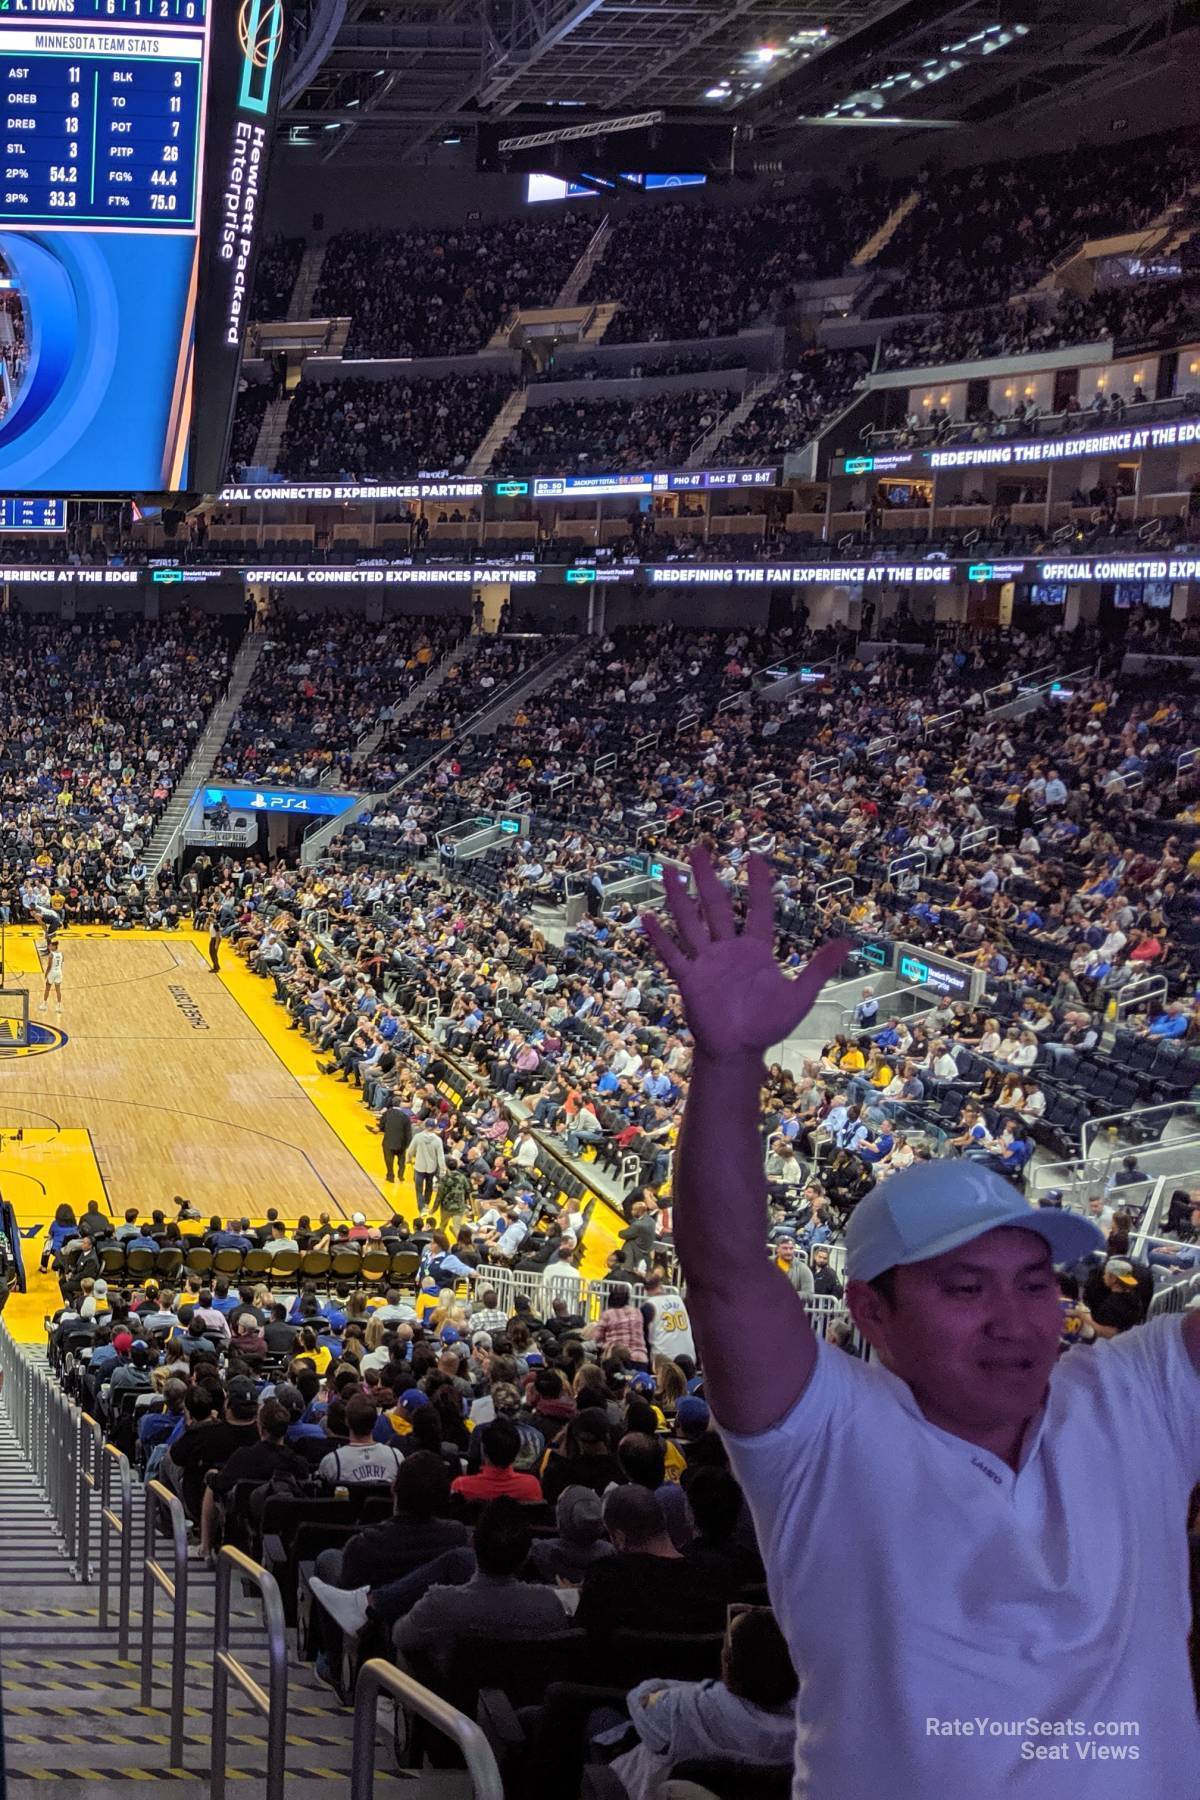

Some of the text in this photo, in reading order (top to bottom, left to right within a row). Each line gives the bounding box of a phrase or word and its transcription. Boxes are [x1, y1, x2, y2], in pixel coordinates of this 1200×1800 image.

[30, 0, 74, 13] TOWNS
[160, 2, 168, 16] 2
[186, 4, 194, 18] 0
[35, 34, 159, 53] MINNESOTA TEAM STATS
[8, 67, 80, 83] AST 11
[113, 72, 182, 87] BLK 3
[8, 92, 79, 108] OREB 8
[112, 97, 181, 112] TO 11
[7, 117, 78, 133] DREB 13
[112, 121, 179, 137] POT 7
[7, 142, 78, 158] STL 3
[110, 146, 178, 161] PITP 26
[6, 167, 77, 182] 2P% 54.2
[110, 170, 177, 186] FG% 44.4
[6, 191, 76, 206] 3P% 33.3
[222, 122, 251, 259] Enterprise
[108, 195, 176, 210] FT% 75.0
[227, 126, 265, 344] Hewlett Packard
[931, 450, 1011, 466] REDEFINING
[1014, 448, 1040, 462] THE
[1043, 444, 1063, 459] FAN
[1065, 432, 1131, 456] EXPERIENCE
[1133, 432, 1149, 447] AT
[1151, 429, 1175, 444] THE
[691, 476, 700, 484] 47
[255, 487, 332, 499] CONNECTED
[334, 486, 418, 498] EXPERIENCES
[422, 484, 482, 496] PARTNER
[58, 570, 76, 582] AT
[79, 570, 102, 582] THE
[106, 571, 138, 582] EDGE
[247, 571, 536, 582] OFFICIAL CONNECTED EXPERIENCES PARTNER
[654, 567, 950, 582] REDEFINING THE FAN EXPERIENCE AT THE EDGE
[1043, 564, 1091, 579] OFFICIAL
[1094, 563, 1166, 578] CONNECTED
[271, 798, 308, 809] PS4
[352, 1464, 386, 1480] CURRY
